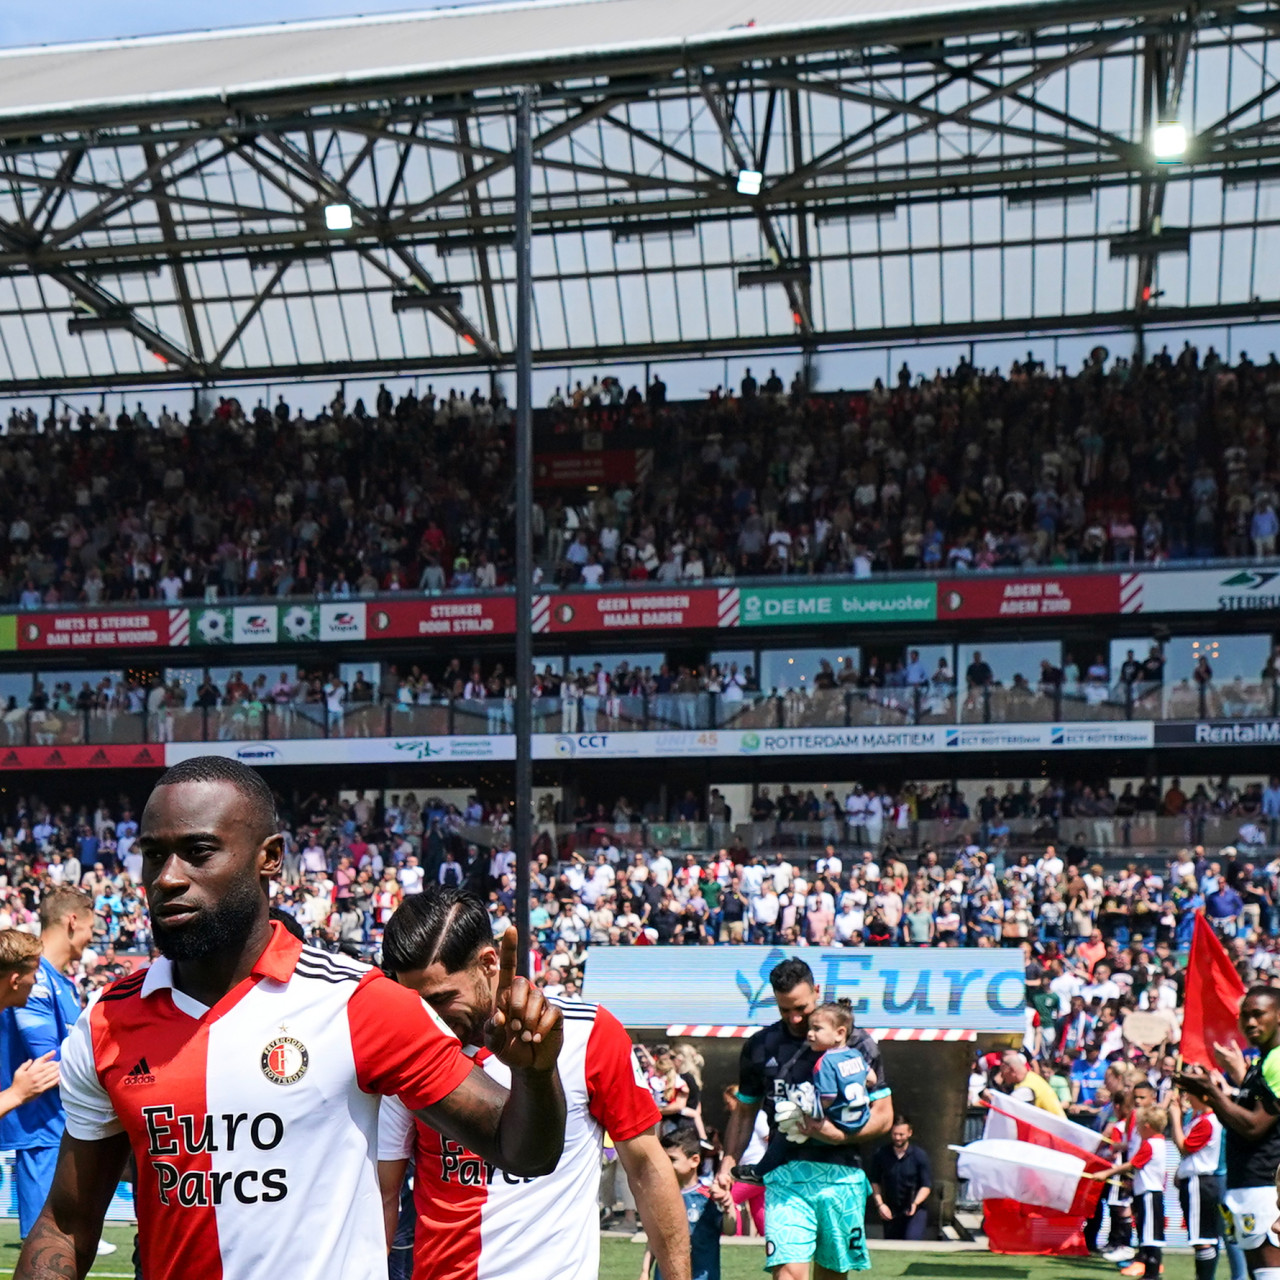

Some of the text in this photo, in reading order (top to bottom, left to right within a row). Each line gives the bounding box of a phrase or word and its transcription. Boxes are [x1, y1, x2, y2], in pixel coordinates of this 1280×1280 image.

[763, 595, 930, 616] DEME bluewater
[578, 735, 609, 748] CCT
[764, 732, 935, 751] ROTTERDAM MARITIEM
[821, 953, 1026, 1017] Euro
[123, 1073, 156, 1086] adidas
[142, 1104, 286, 1157] Euro
[152, 1160, 289, 1207] Parcs
